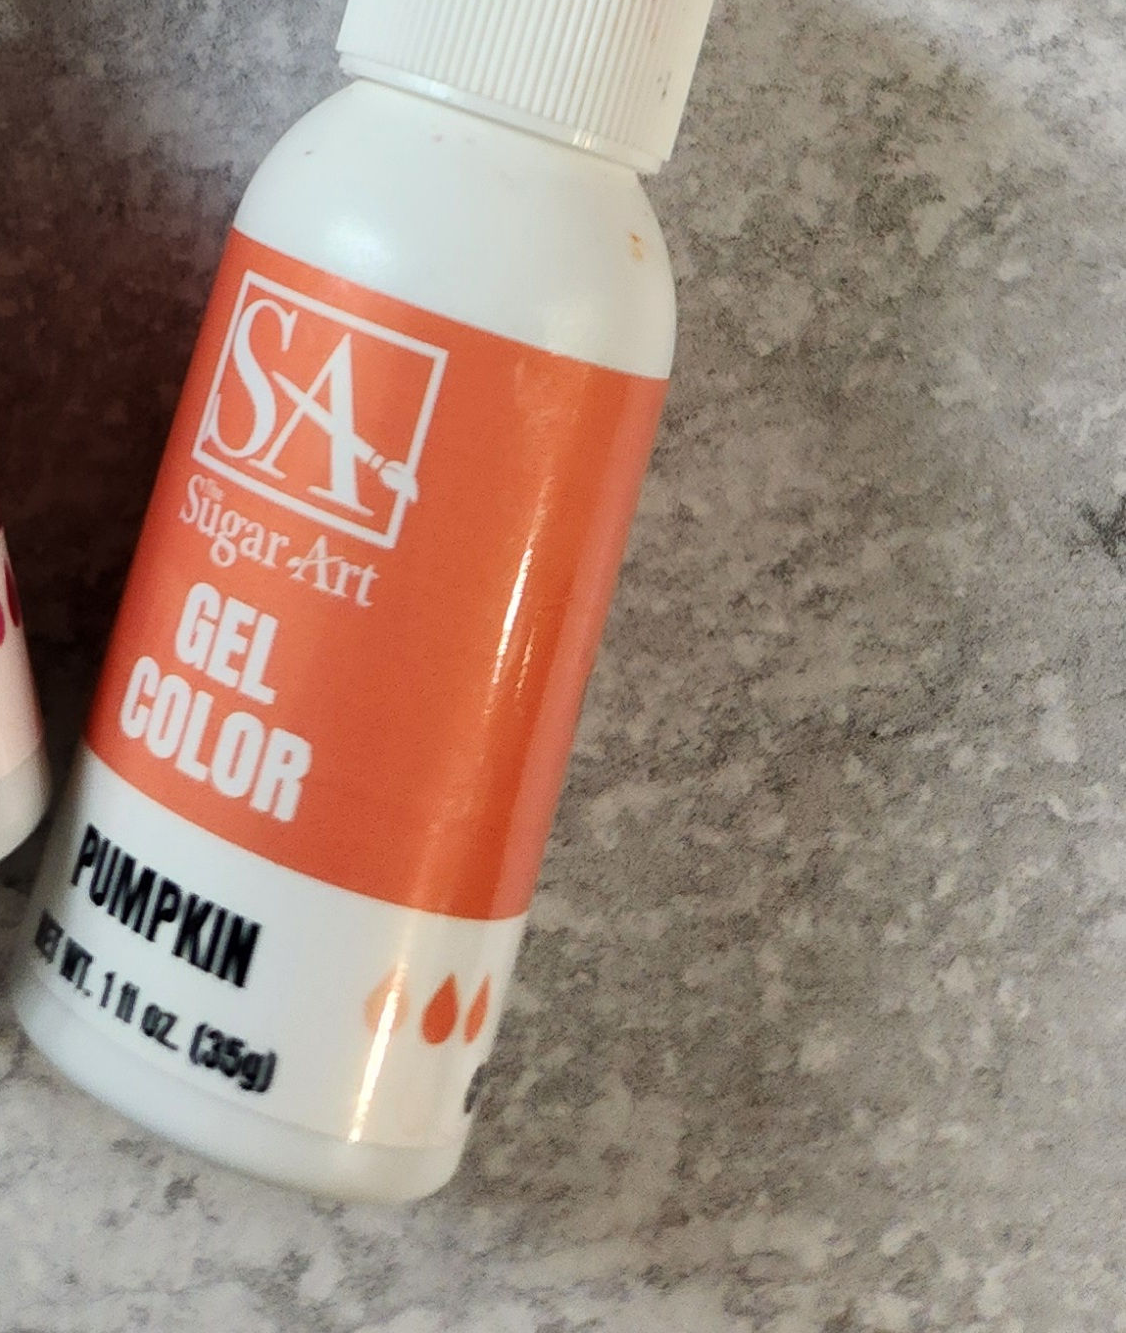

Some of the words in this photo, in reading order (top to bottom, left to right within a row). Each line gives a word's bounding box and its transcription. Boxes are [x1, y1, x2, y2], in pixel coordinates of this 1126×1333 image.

[178, 473, 290, 567] Sugar
[174, 582, 278, 706] GEL
[119, 656, 312, 822] COLOR
[71, 824, 262, 989] PUMPKIN
[99, 972, 116, 1008] 1
[189, 1022, 277, 1093] (35g)
